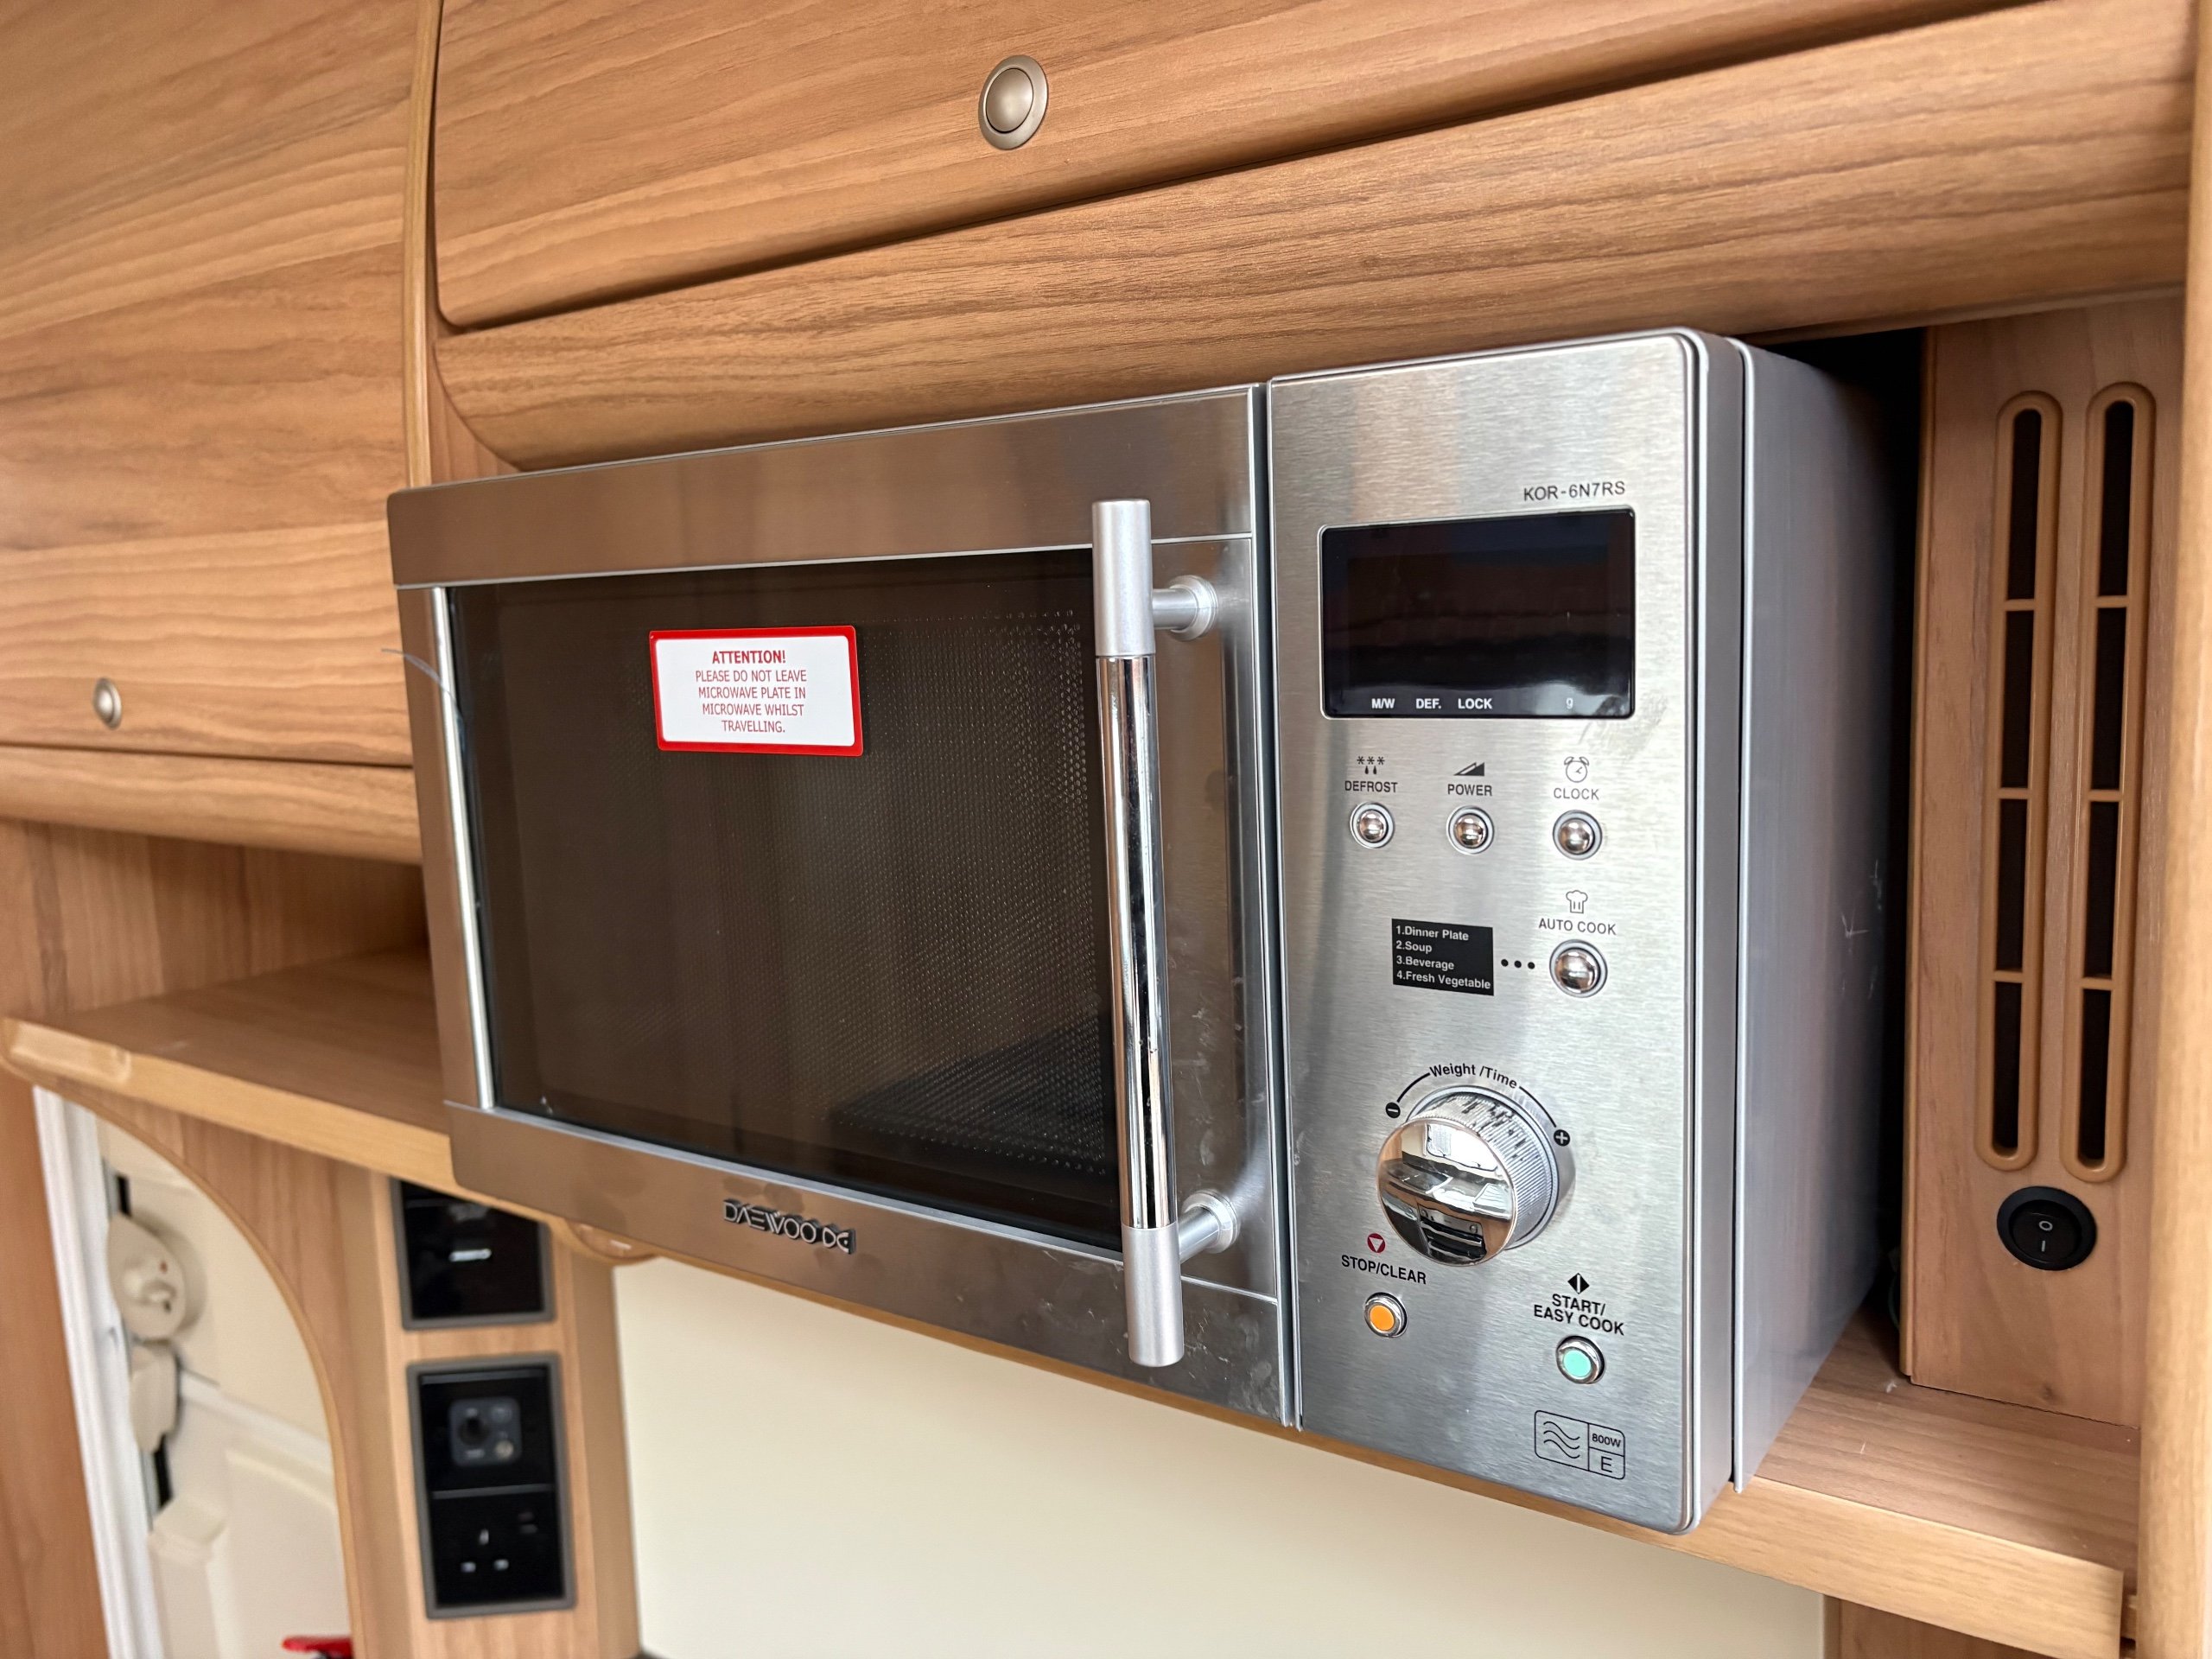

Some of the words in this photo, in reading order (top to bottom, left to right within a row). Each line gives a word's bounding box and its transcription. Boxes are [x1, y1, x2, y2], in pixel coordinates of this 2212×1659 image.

[1523, 481, 1625, 501] KOR-6N7RS
[712, 650, 785, 664] ATTENTION!
[696, 670, 730, 683] PLEASE
[734, 671, 747, 682] DO
[751, 670, 772, 683] NOT
[776, 670, 807, 683] LEAVE
[698, 687, 758, 699] MICROWAVE
[761, 687, 790, 699] PLATE
[794, 687, 806, 699] IN
[702, 703, 761, 716] MICROWAVE
[765, 703, 804, 716] WHILST
[1371, 698, 1395, 709] M/W
[1415, 698, 1442, 709] DEF.
[1458, 698, 1493, 709] LOCK
[721, 720, 785, 733] TRAVELLING.
[1344, 780, 1398, 793] DEFROST
[1447, 783, 1493, 797] POWER
[1554, 787, 1600, 801] CLOCK
[1539, 918, 1574, 931] AUTO
[1577, 920, 1617, 936] COOK
[1442, 929, 1469, 941] Plate
[1438, 974, 1491, 989] Vegetable
[1429, 1063, 1476, 1077] Weight
[723, 1198, 821, 1243] DAEWOO
[1341, 1255, 1427, 1285] STOP/CLEAR
[1552, 1294, 1606, 1316] START/
[1534, 1305, 1574, 1324] EASY
[1579, 1315, 1624, 1336] COOK
[1592, 1432, 1622, 1448] 800W
[1600, 1457, 1612, 1473] E
